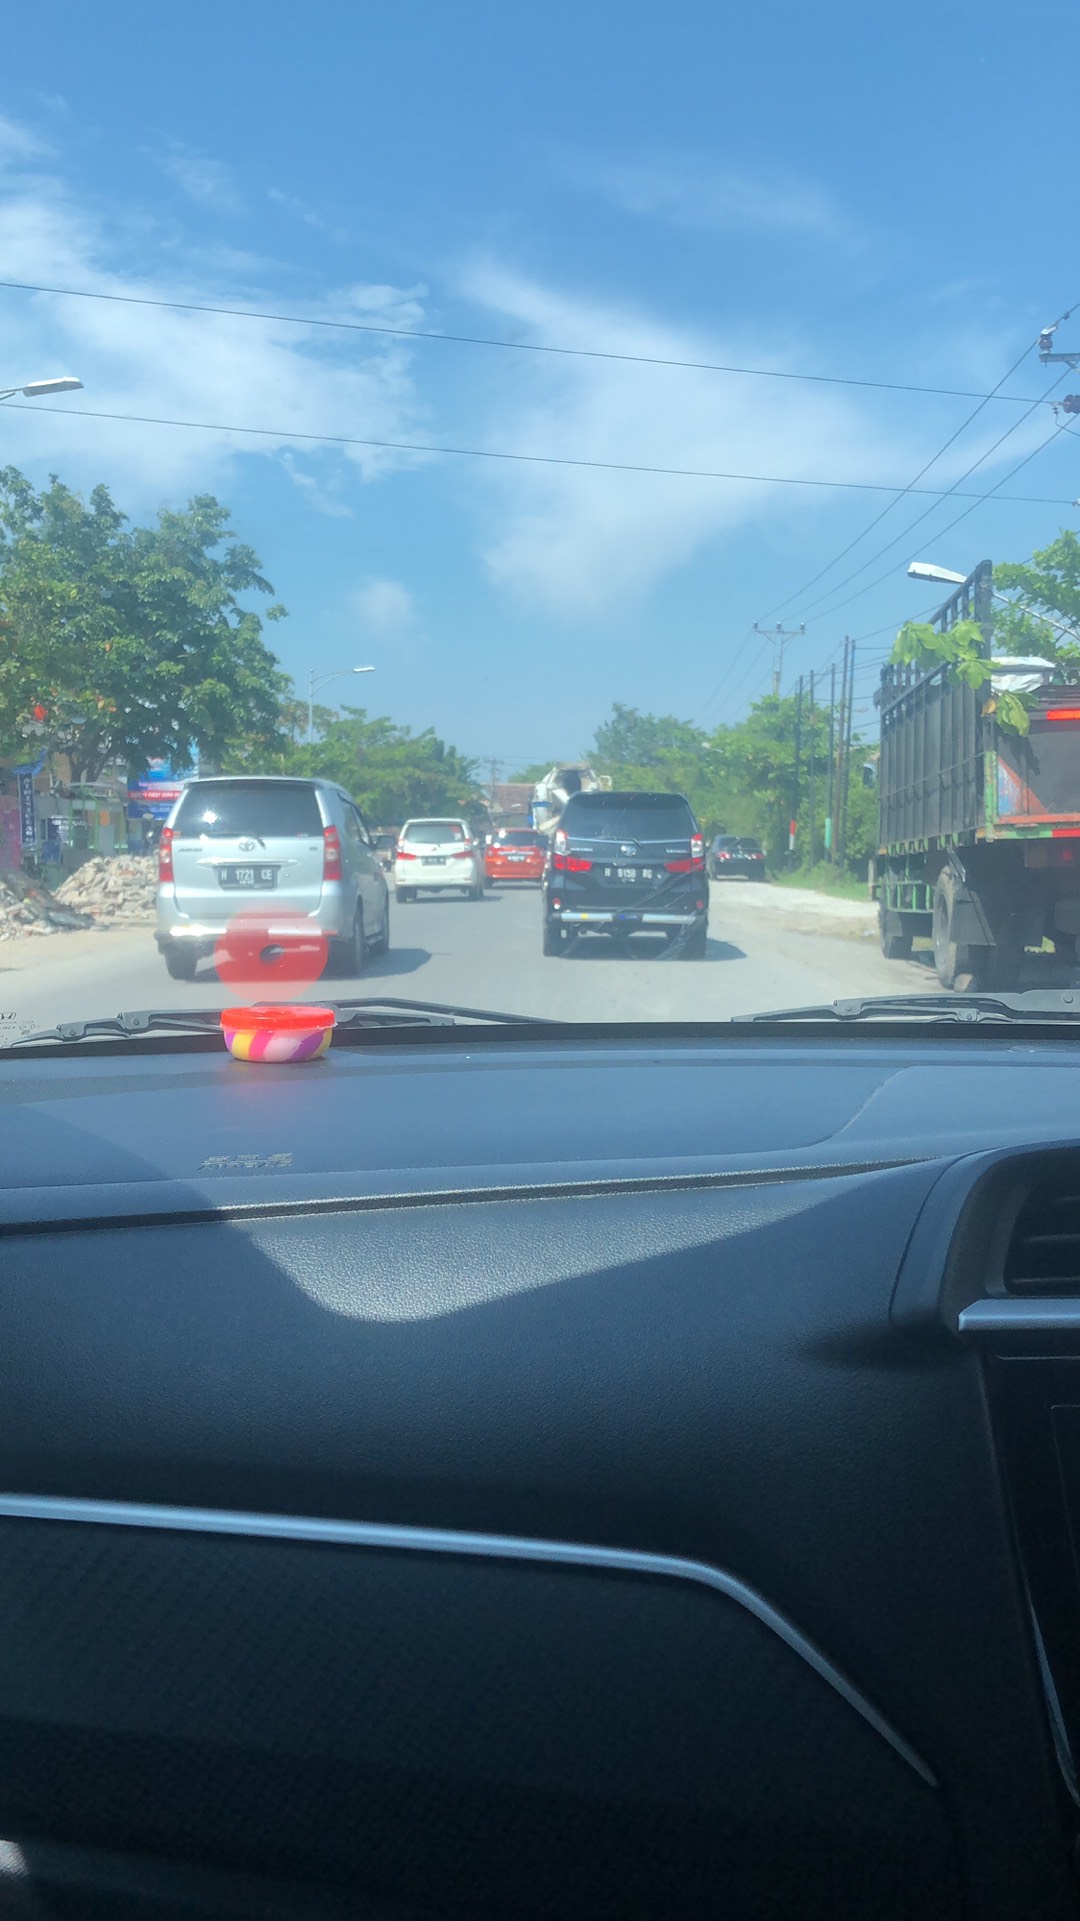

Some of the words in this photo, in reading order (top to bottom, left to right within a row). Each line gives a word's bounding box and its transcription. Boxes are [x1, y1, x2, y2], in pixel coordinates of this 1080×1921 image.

[221, 870, 228, 880] H
[235, 869, 254, 880] 1721
[604, 868, 611, 877] H
